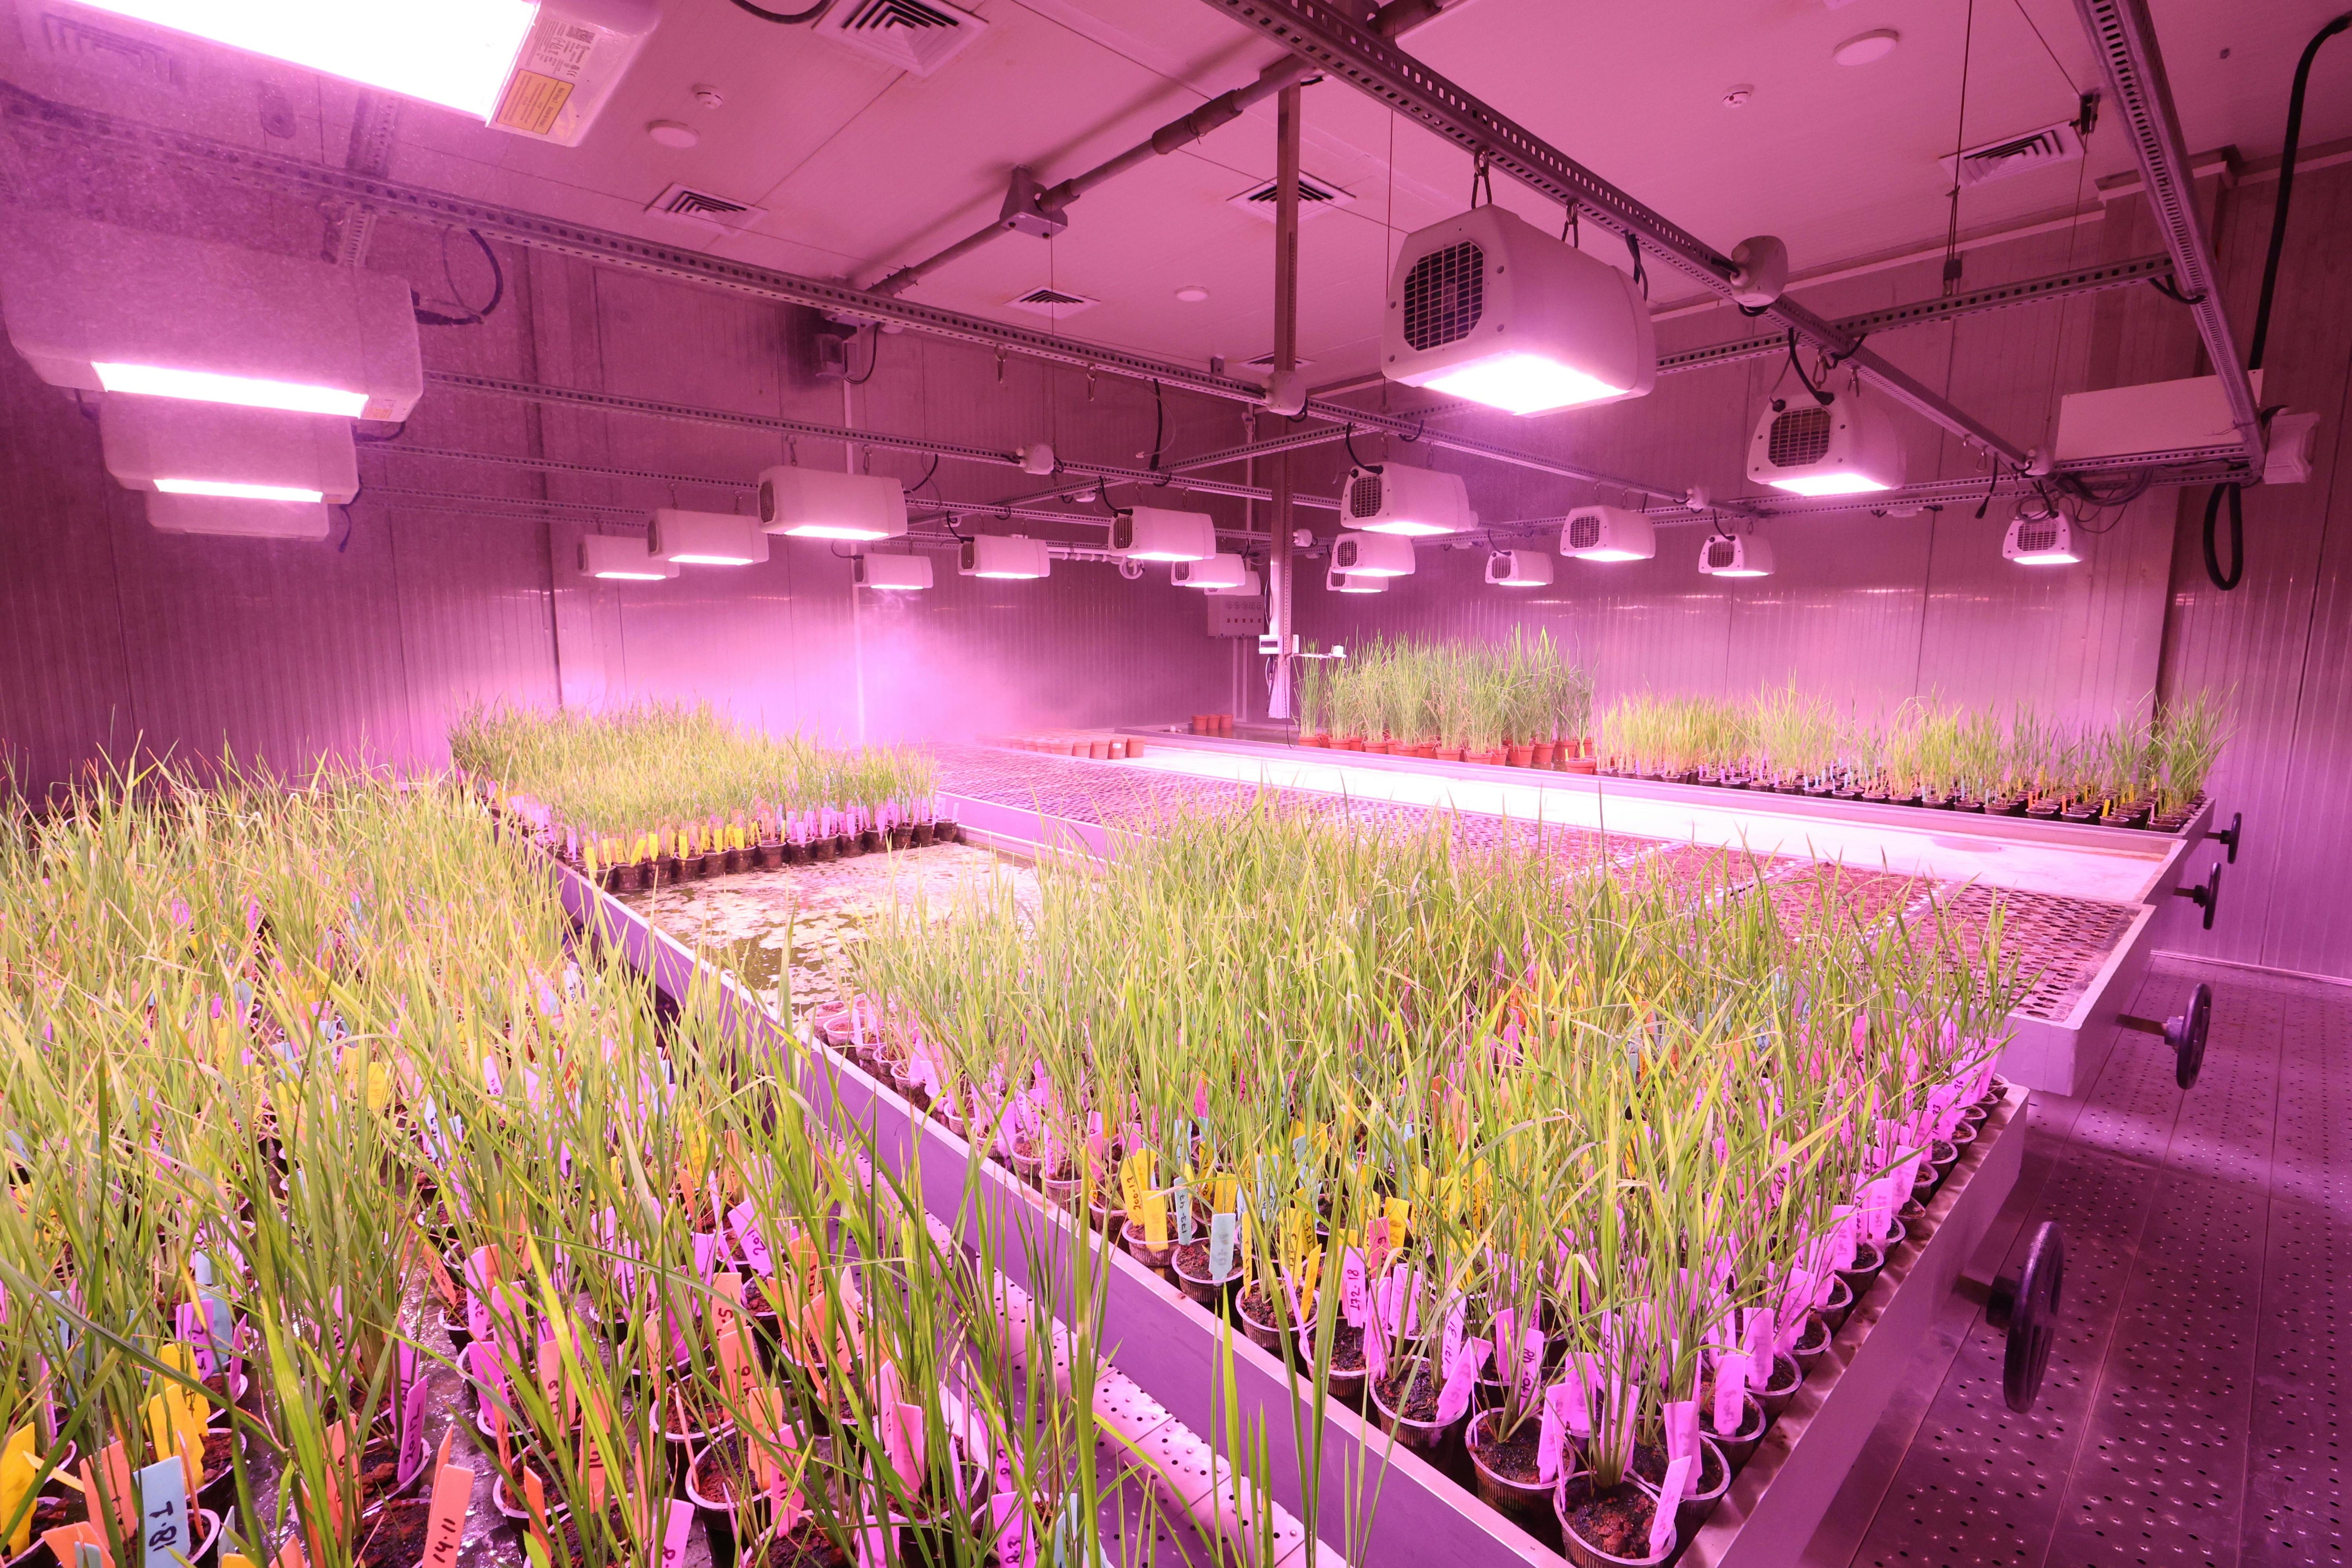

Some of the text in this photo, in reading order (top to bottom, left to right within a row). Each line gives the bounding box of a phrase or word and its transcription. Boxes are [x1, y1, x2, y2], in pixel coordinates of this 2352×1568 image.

[1127, 1176, 1141, 1210] 200-13
[1445, 1323, 1456, 1364] 171-31
[404, 1403, 420, 1463] 20.12
[148, 1500, 178, 1551] 18.1
[433, 1518, 456, 1563] 14.11
